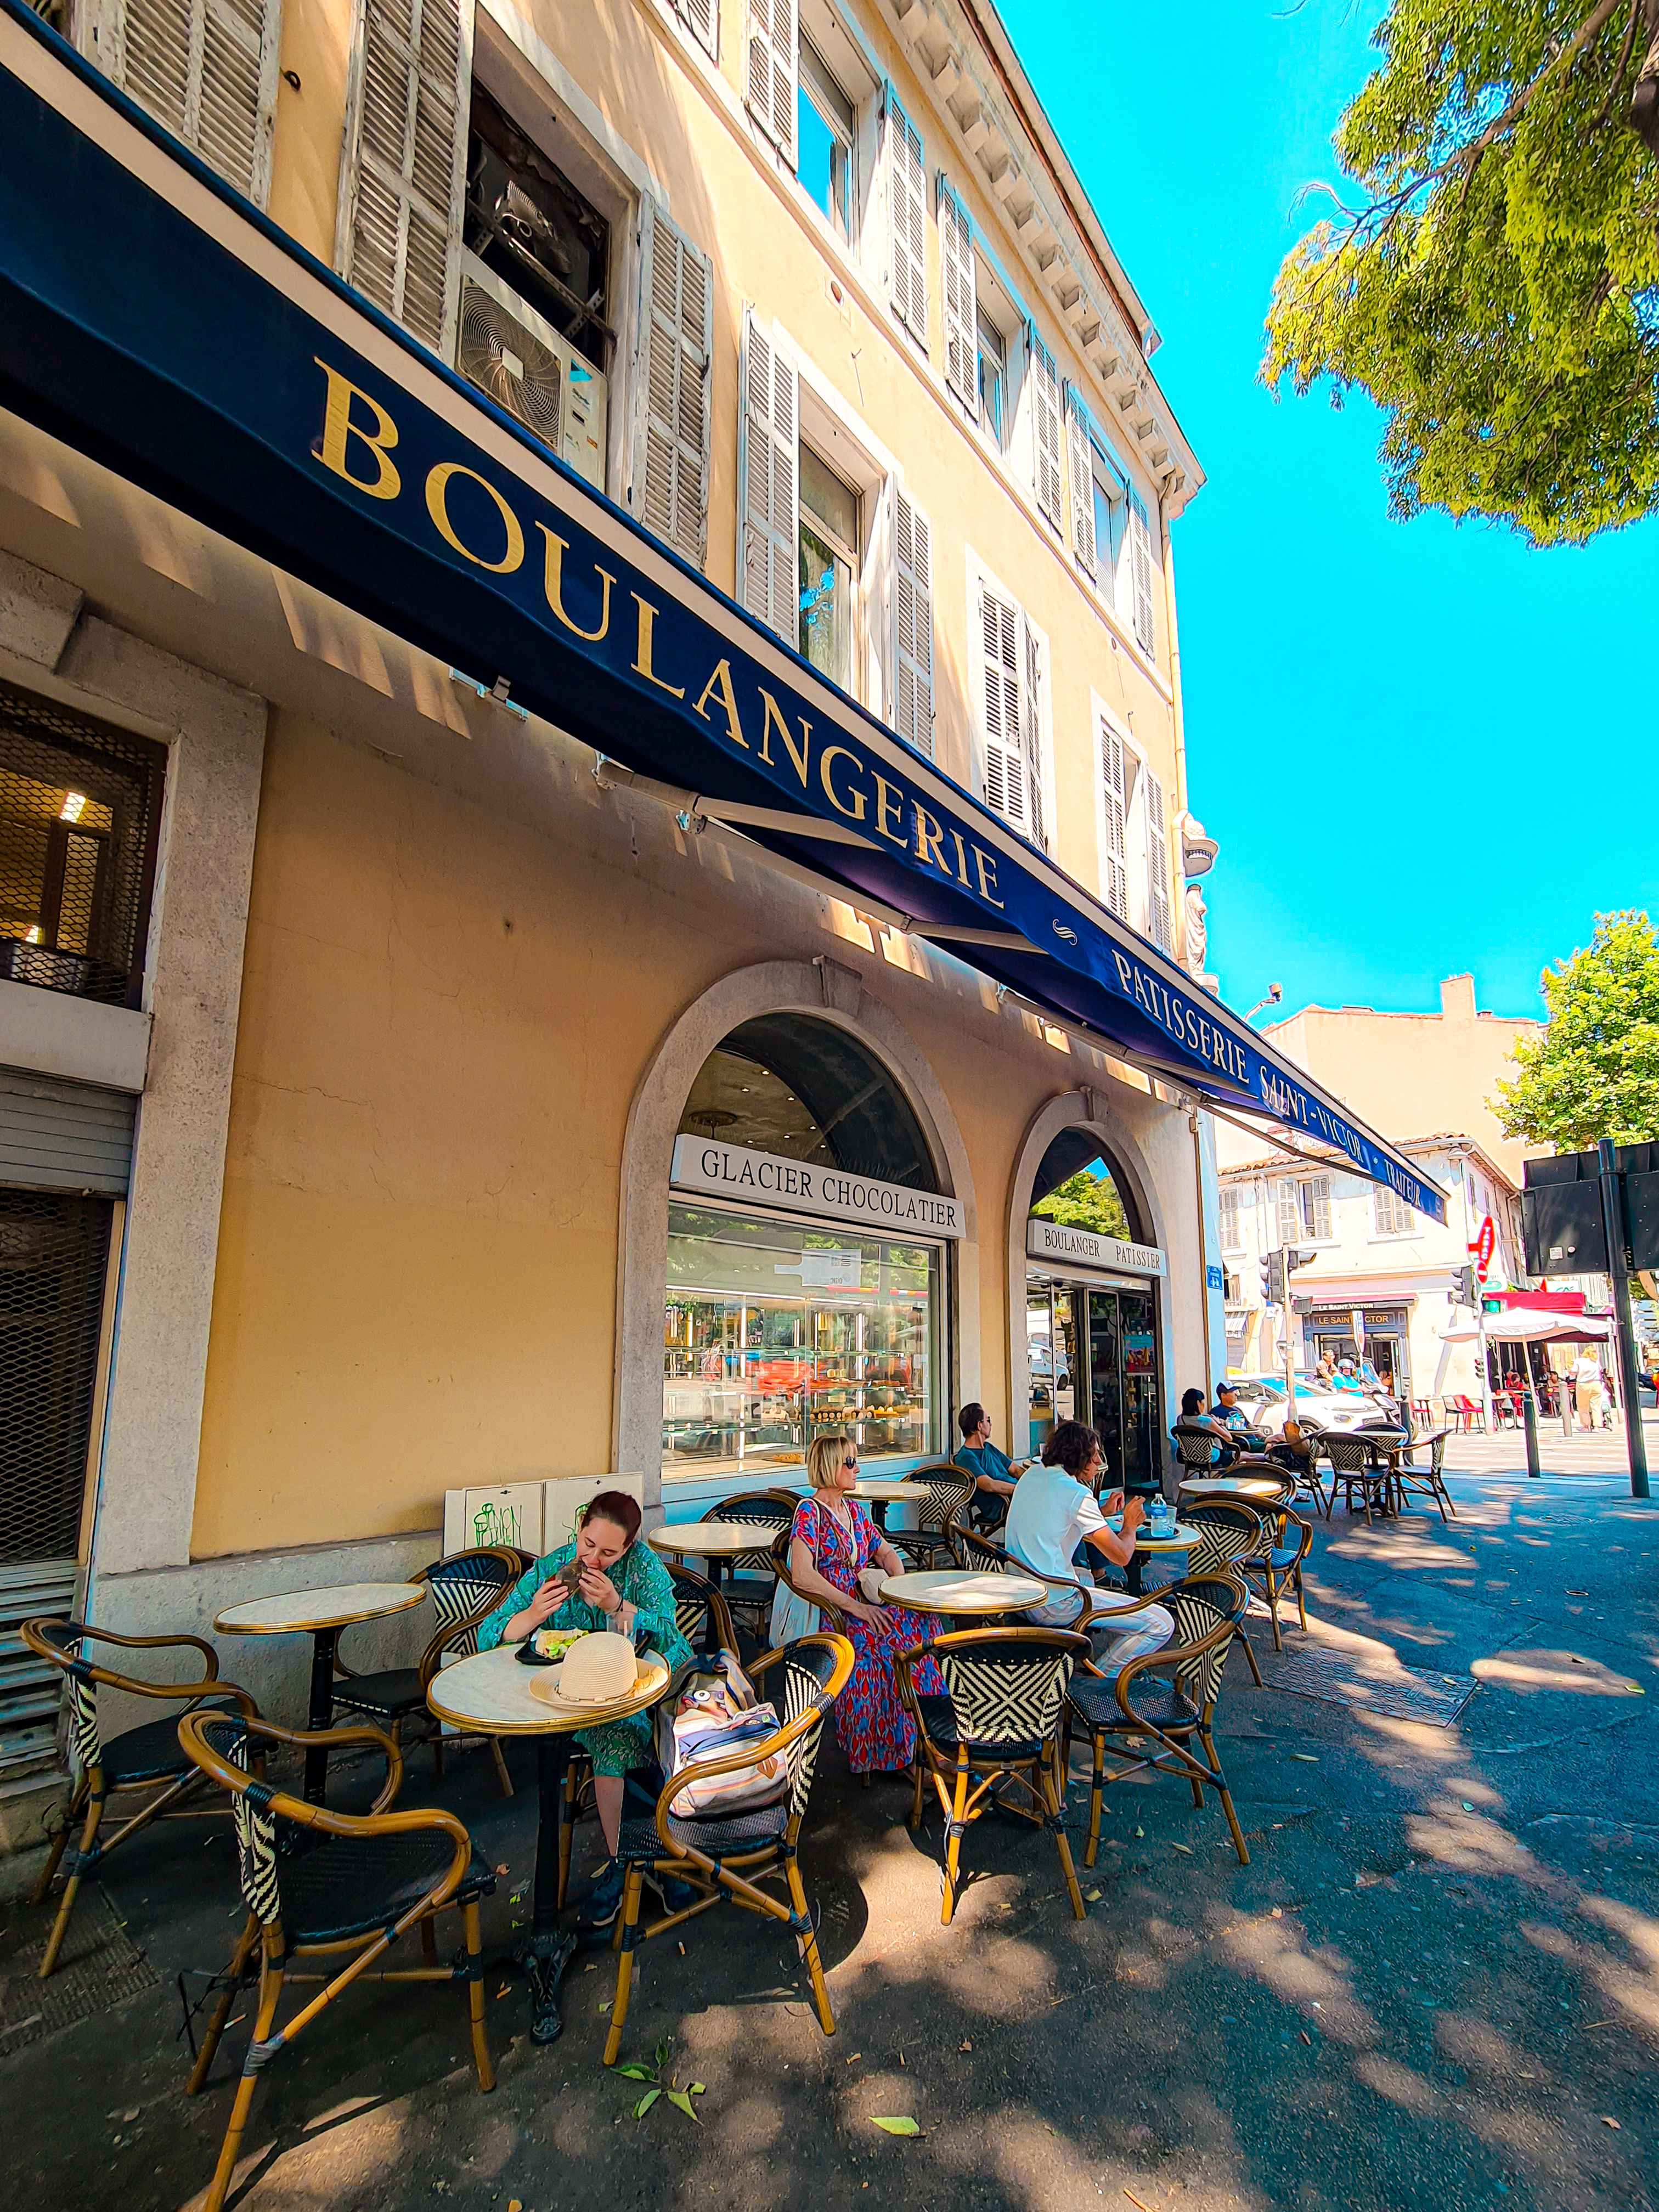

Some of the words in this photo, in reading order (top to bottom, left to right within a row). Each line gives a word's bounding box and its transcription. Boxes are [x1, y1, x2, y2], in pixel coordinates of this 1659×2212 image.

[311, 356, 1004, 909] BOULANGERIE
[1111, 949, 1250, 1084] PATISSERIE
[1260, 1065, 1364, 1164] SAINT-VICTOR
[1384, 1159, 1422, 1207] TRAITEUR
[701, 1149, 814, 1198] GLACIER
[822, 1177, 957, 1228] CHOCOLATIER
[1043, 1228, 1100, 1257] BOULANGER
[1115, 1245, 1160, 1270] PATISSIER
[1364, 1315, 1389, 1323] CTOR
